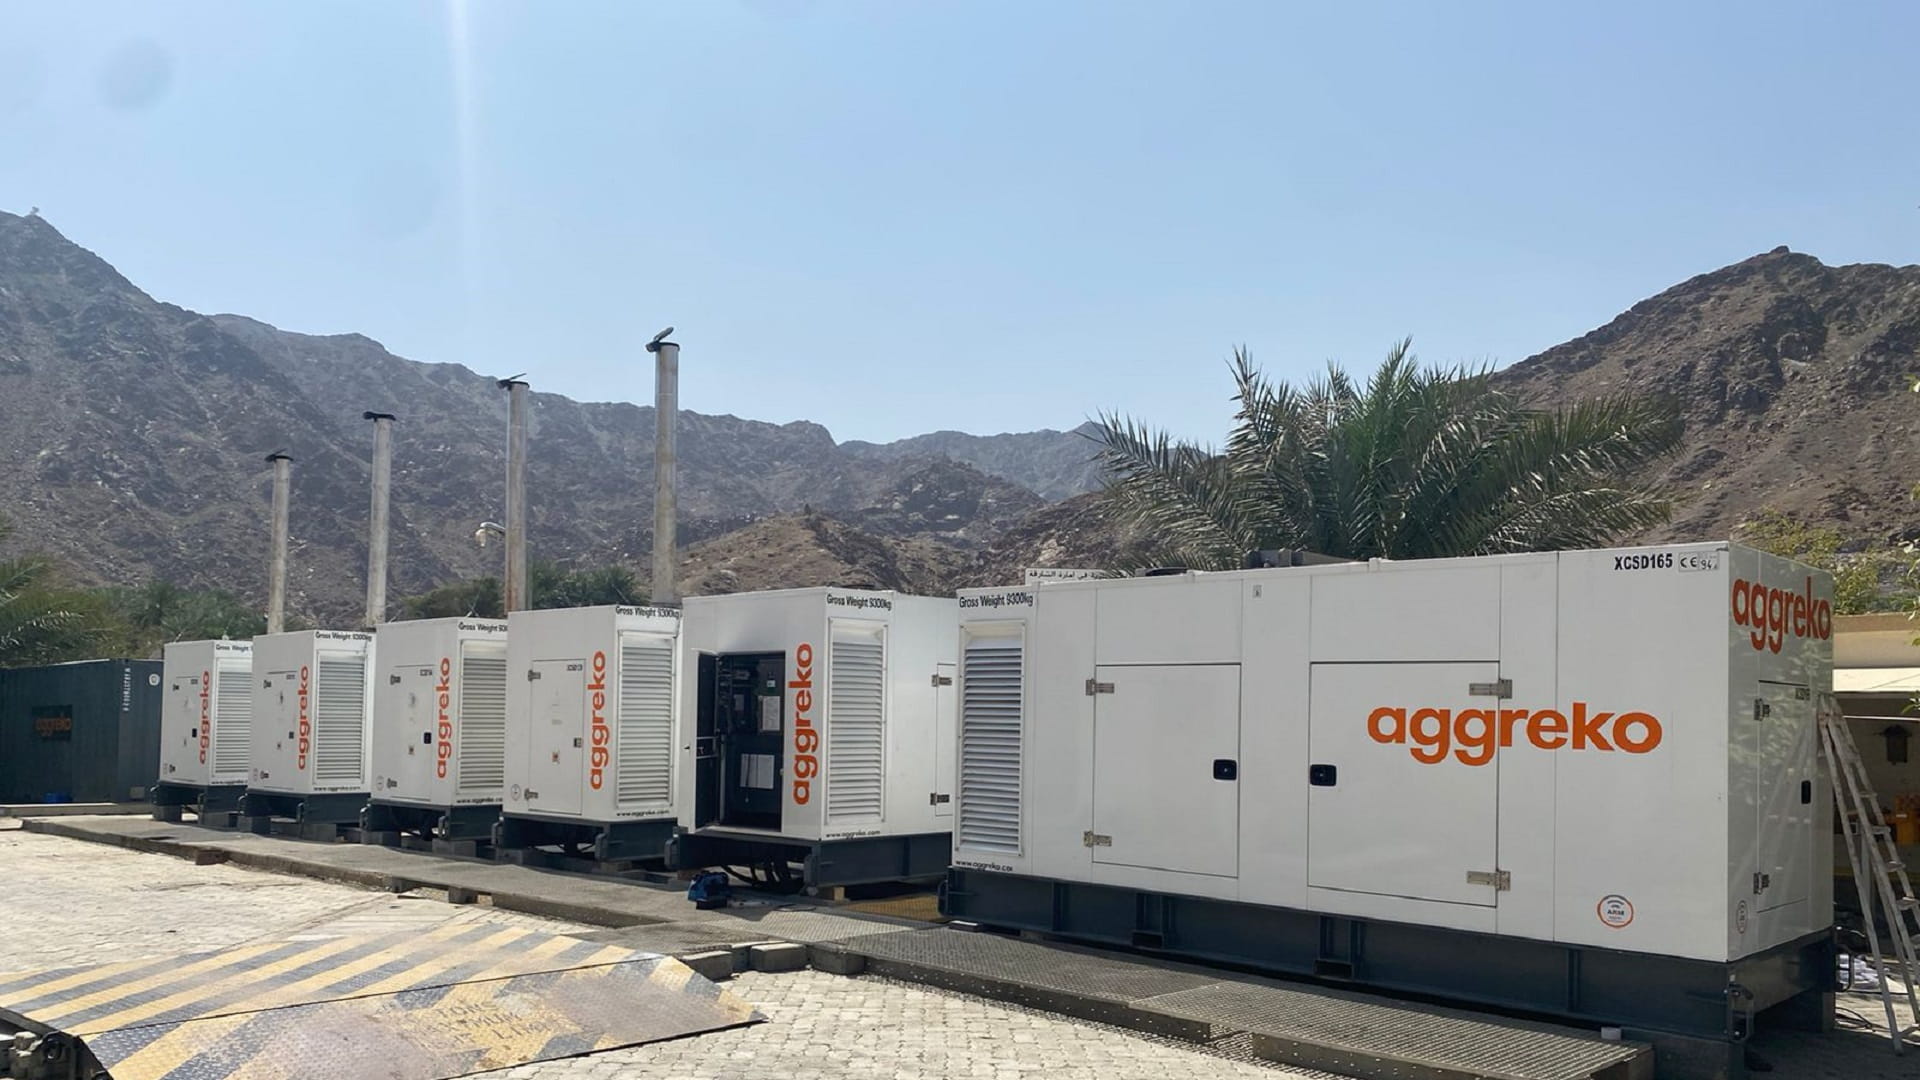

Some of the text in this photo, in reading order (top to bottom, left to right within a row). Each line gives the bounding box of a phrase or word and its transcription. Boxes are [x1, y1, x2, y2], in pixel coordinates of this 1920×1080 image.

[1614, 553, 1673, 570] XCSD165
[458, 621, 475, 630] Gross
[477, 624, 497, 634] Weight
[616, 605, 633, 616] Gross
[635, 607, 656, 618] Weight
[827, 593, 892, 611] Gross Weight 9300kg
[959, 592, 1033, 608] Gross Weight 9300kg
[1732, 576, 1831, 654] aggreko
[199, 671, 210, 764] aggreko
[298, 666, 310, 769] aggreko
[436, 657, 453, 779] aggreko
[587, 651, 609, 790] aggreko
[788, 643, 819, 805] aggreko
[1367, 701, 1663, 766] aggreko
